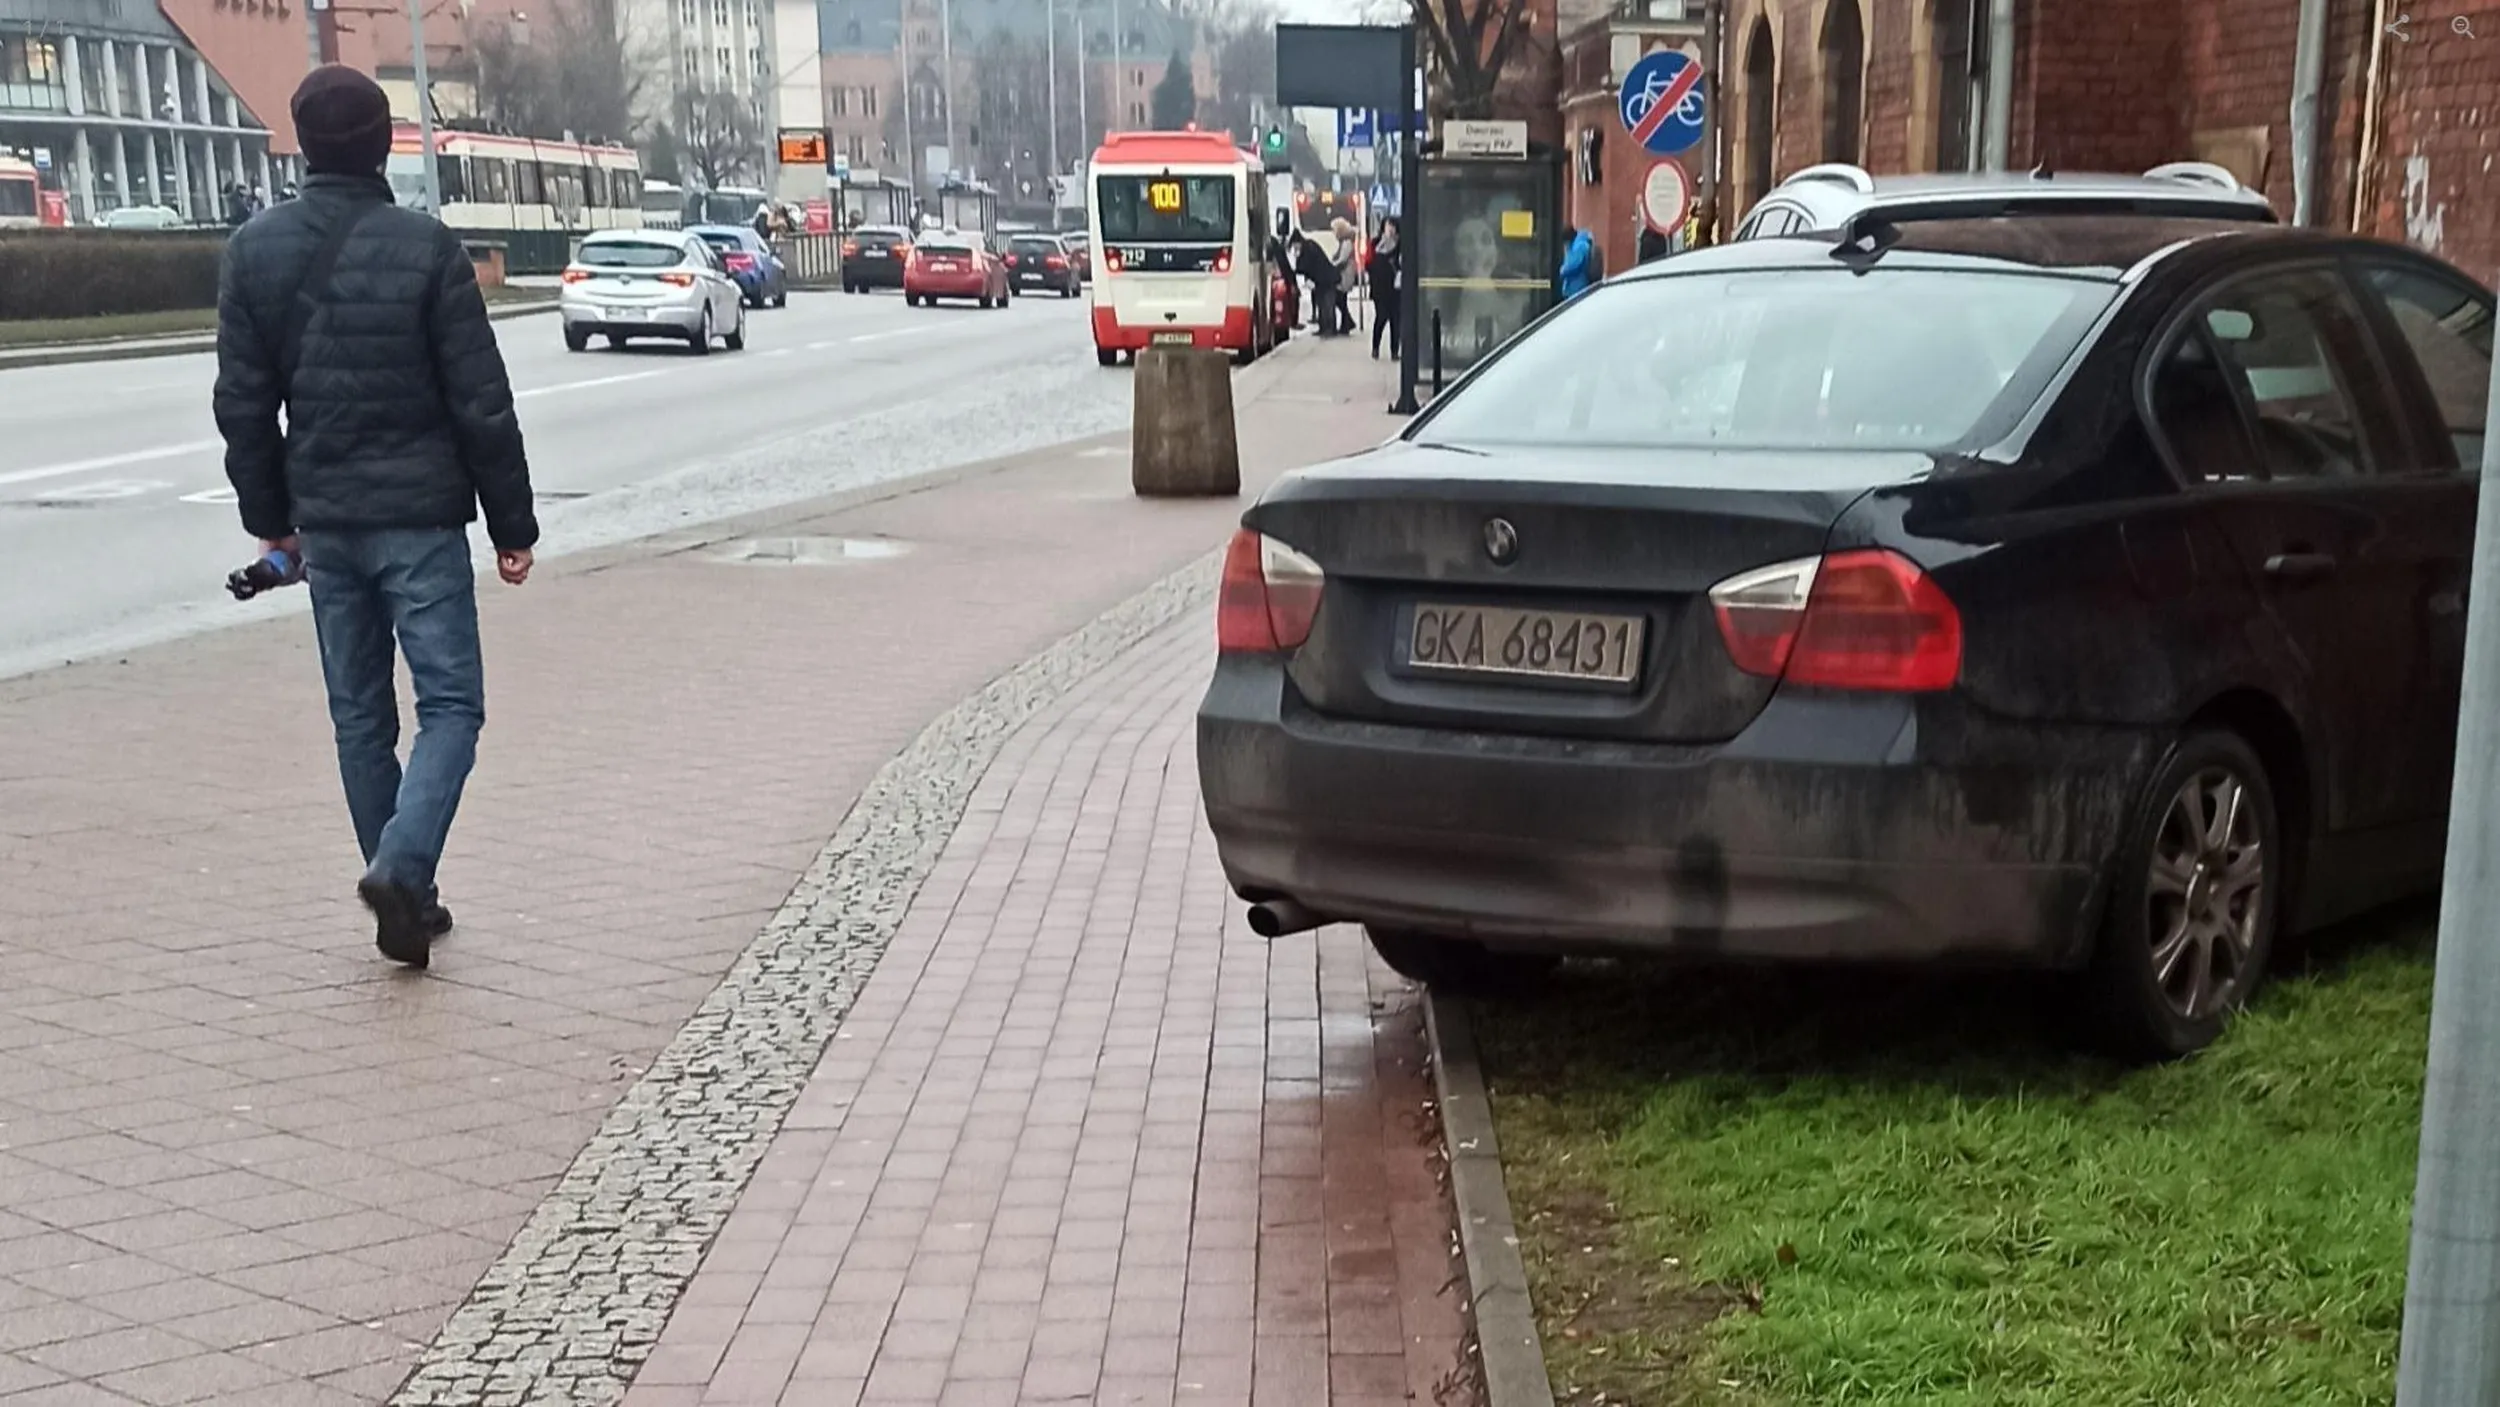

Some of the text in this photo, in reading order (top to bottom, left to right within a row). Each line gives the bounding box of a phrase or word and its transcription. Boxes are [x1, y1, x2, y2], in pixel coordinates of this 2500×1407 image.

[1151, 183, 1180, 209] 100
[1413, 609, 1630, 677] GKA 68431
